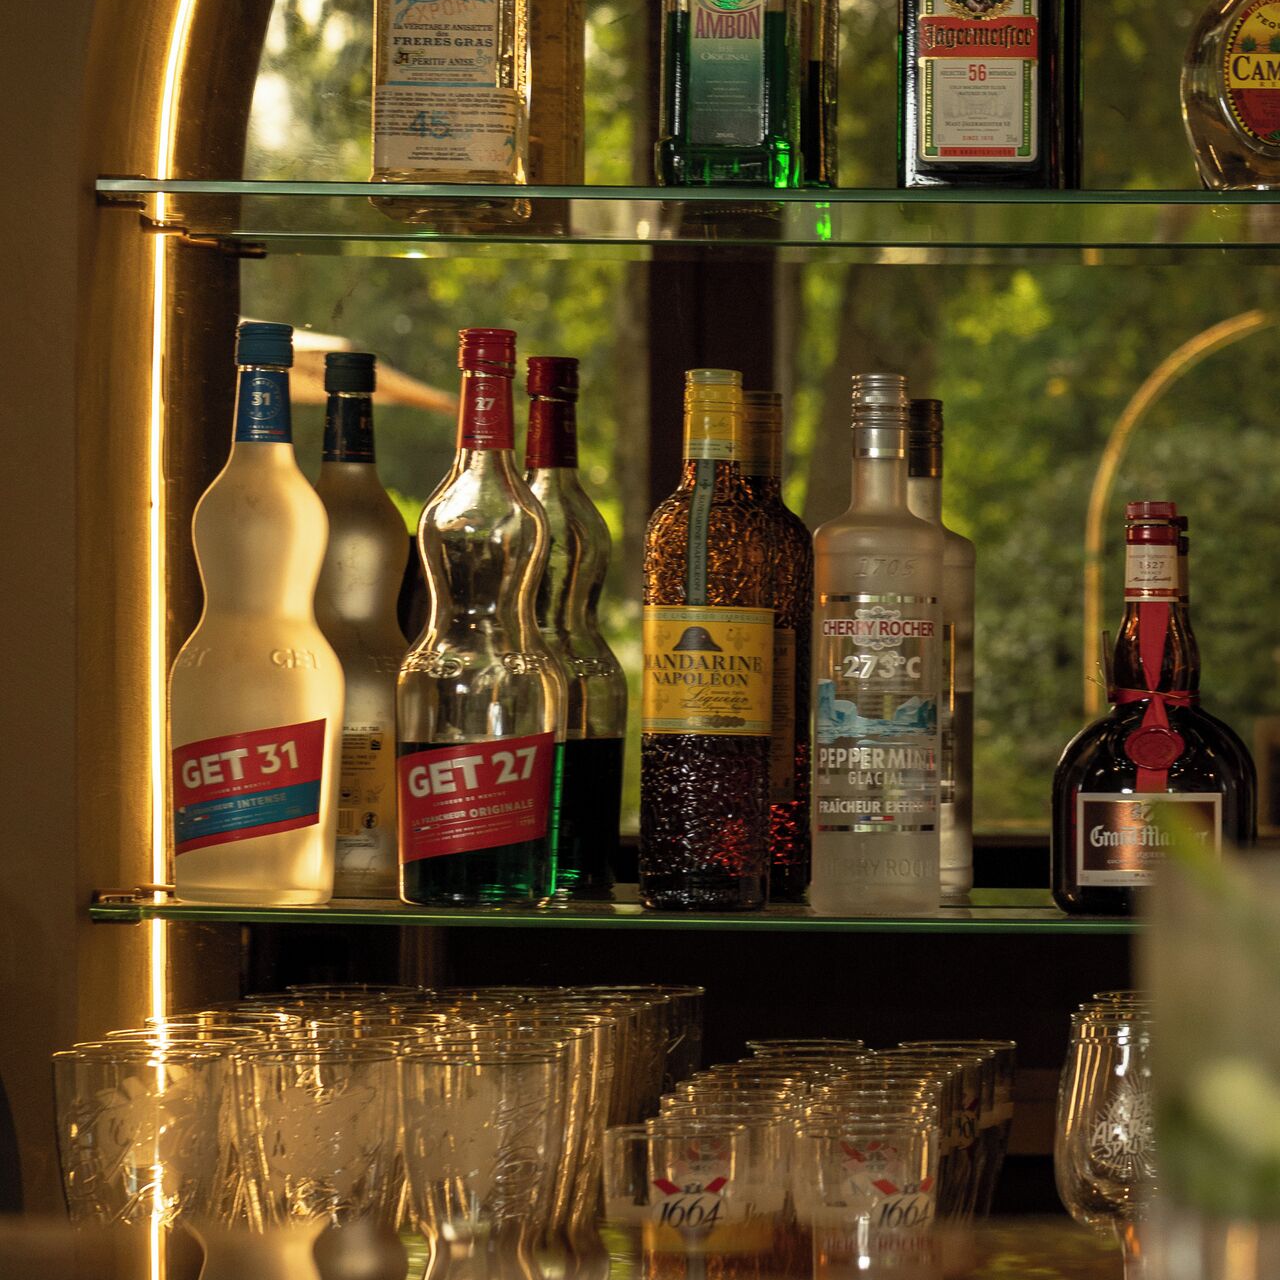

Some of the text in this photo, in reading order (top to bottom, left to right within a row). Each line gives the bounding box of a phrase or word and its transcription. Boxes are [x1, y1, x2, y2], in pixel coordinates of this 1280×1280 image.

[694, 4, 761, 39] AMBON
[455, 38, 494, 48] GRAS
[924, 23, 1034, 49] Jägermeister
[968, 64, 987, 81] 56
[251, 391, 271, 406] 31
[475, 397, 496, 411] 27
[822, 621, 935, 636] CHERRY ROCHER
[644, 653, 763, 673] MANDARINE
[652, 669, 749, 686] NAPOLÉON
[181, 748, 249, 789] GET
[256, 740, 299, 774] 31
[408, 746, 538, 798] GET 27
[847, 771, 905, 785] GLACIAL
[237, 792, 288, 810] INTENSE
[468, 798, 535, 814] ORIGINALE
[819, 798, 881, 814] FRAÎCHEUR
[1090, 824, 1137, 848] Grand
[657, 1197, 722, 1229] 1664
[878, 1195, 931, 1228] 1664
